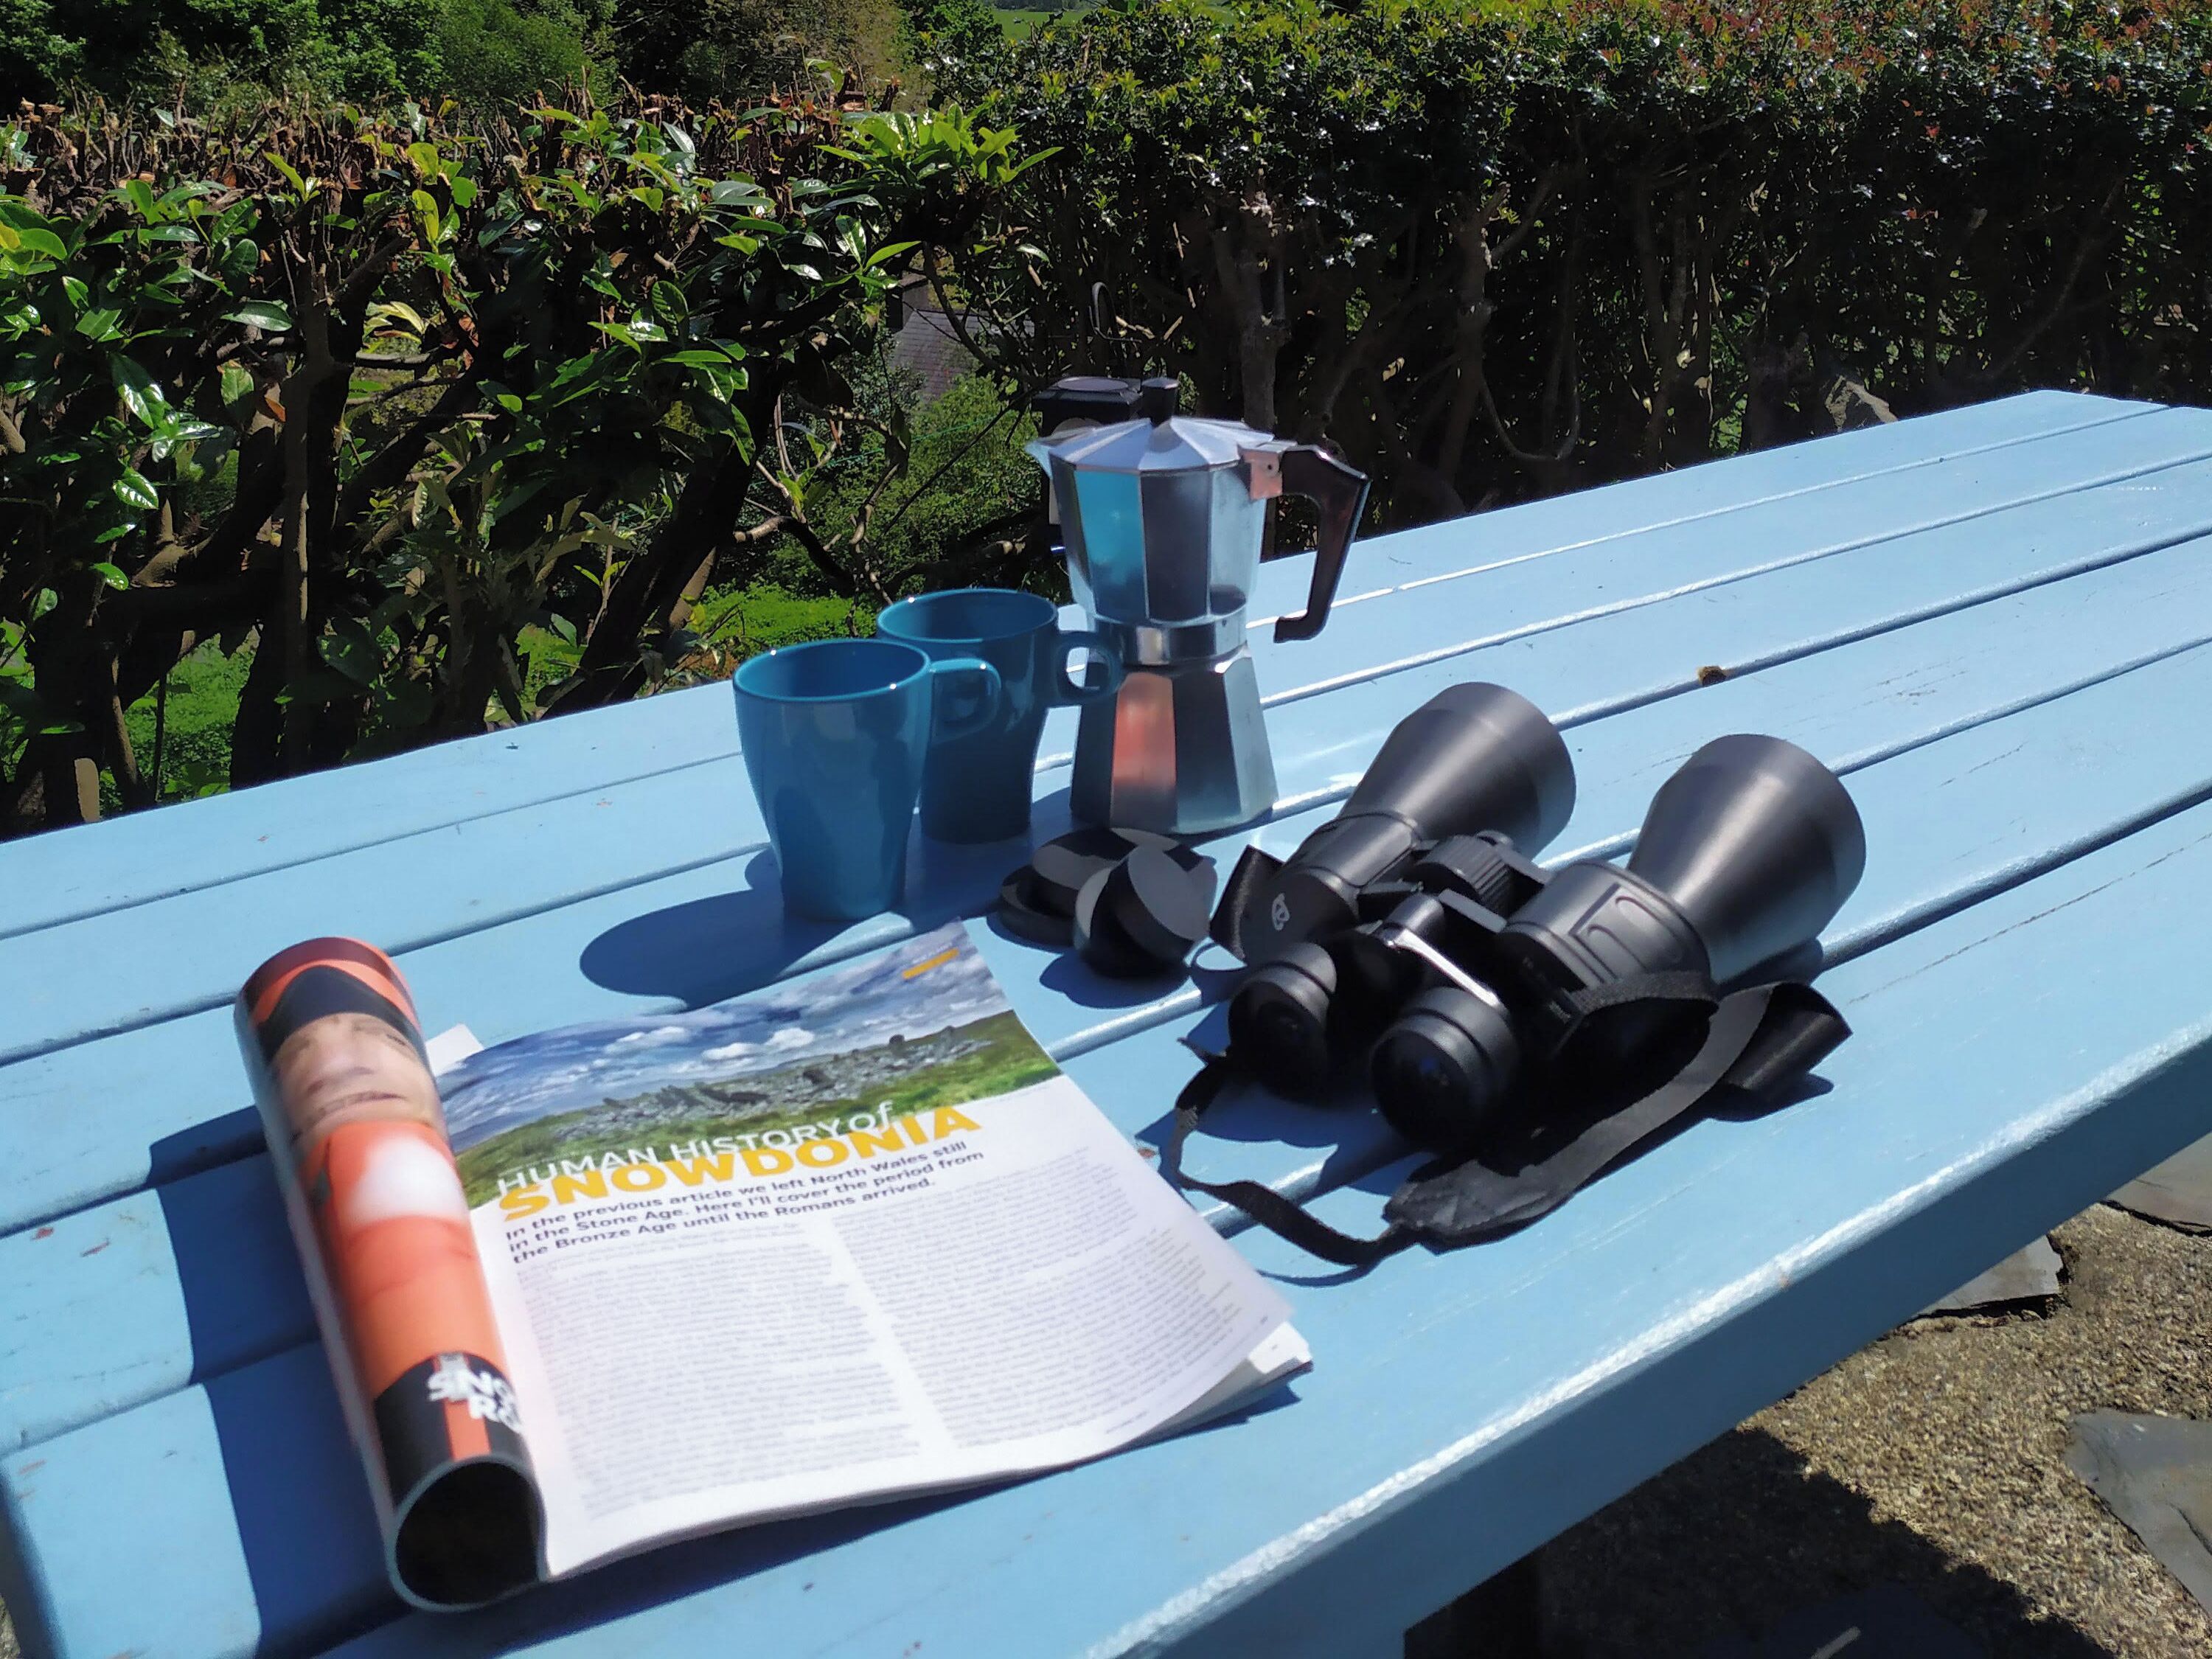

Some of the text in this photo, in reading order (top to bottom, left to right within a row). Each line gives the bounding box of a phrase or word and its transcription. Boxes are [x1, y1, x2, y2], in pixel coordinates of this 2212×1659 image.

[498, 1147, 658, 1195] HUMAN
[670, 1118, 840, 1161] HISTORY
[499, 1105, 983, 1222] SNOWDONIA
[506, 1140, 967, 1240] In the previous article we left North Wales still
[509, 1151, 984, 1252] in the Stone Age. Here I'll cover the period from
[513, 1178, 936, 1264] the Bronze Age until the Romans arrived.
